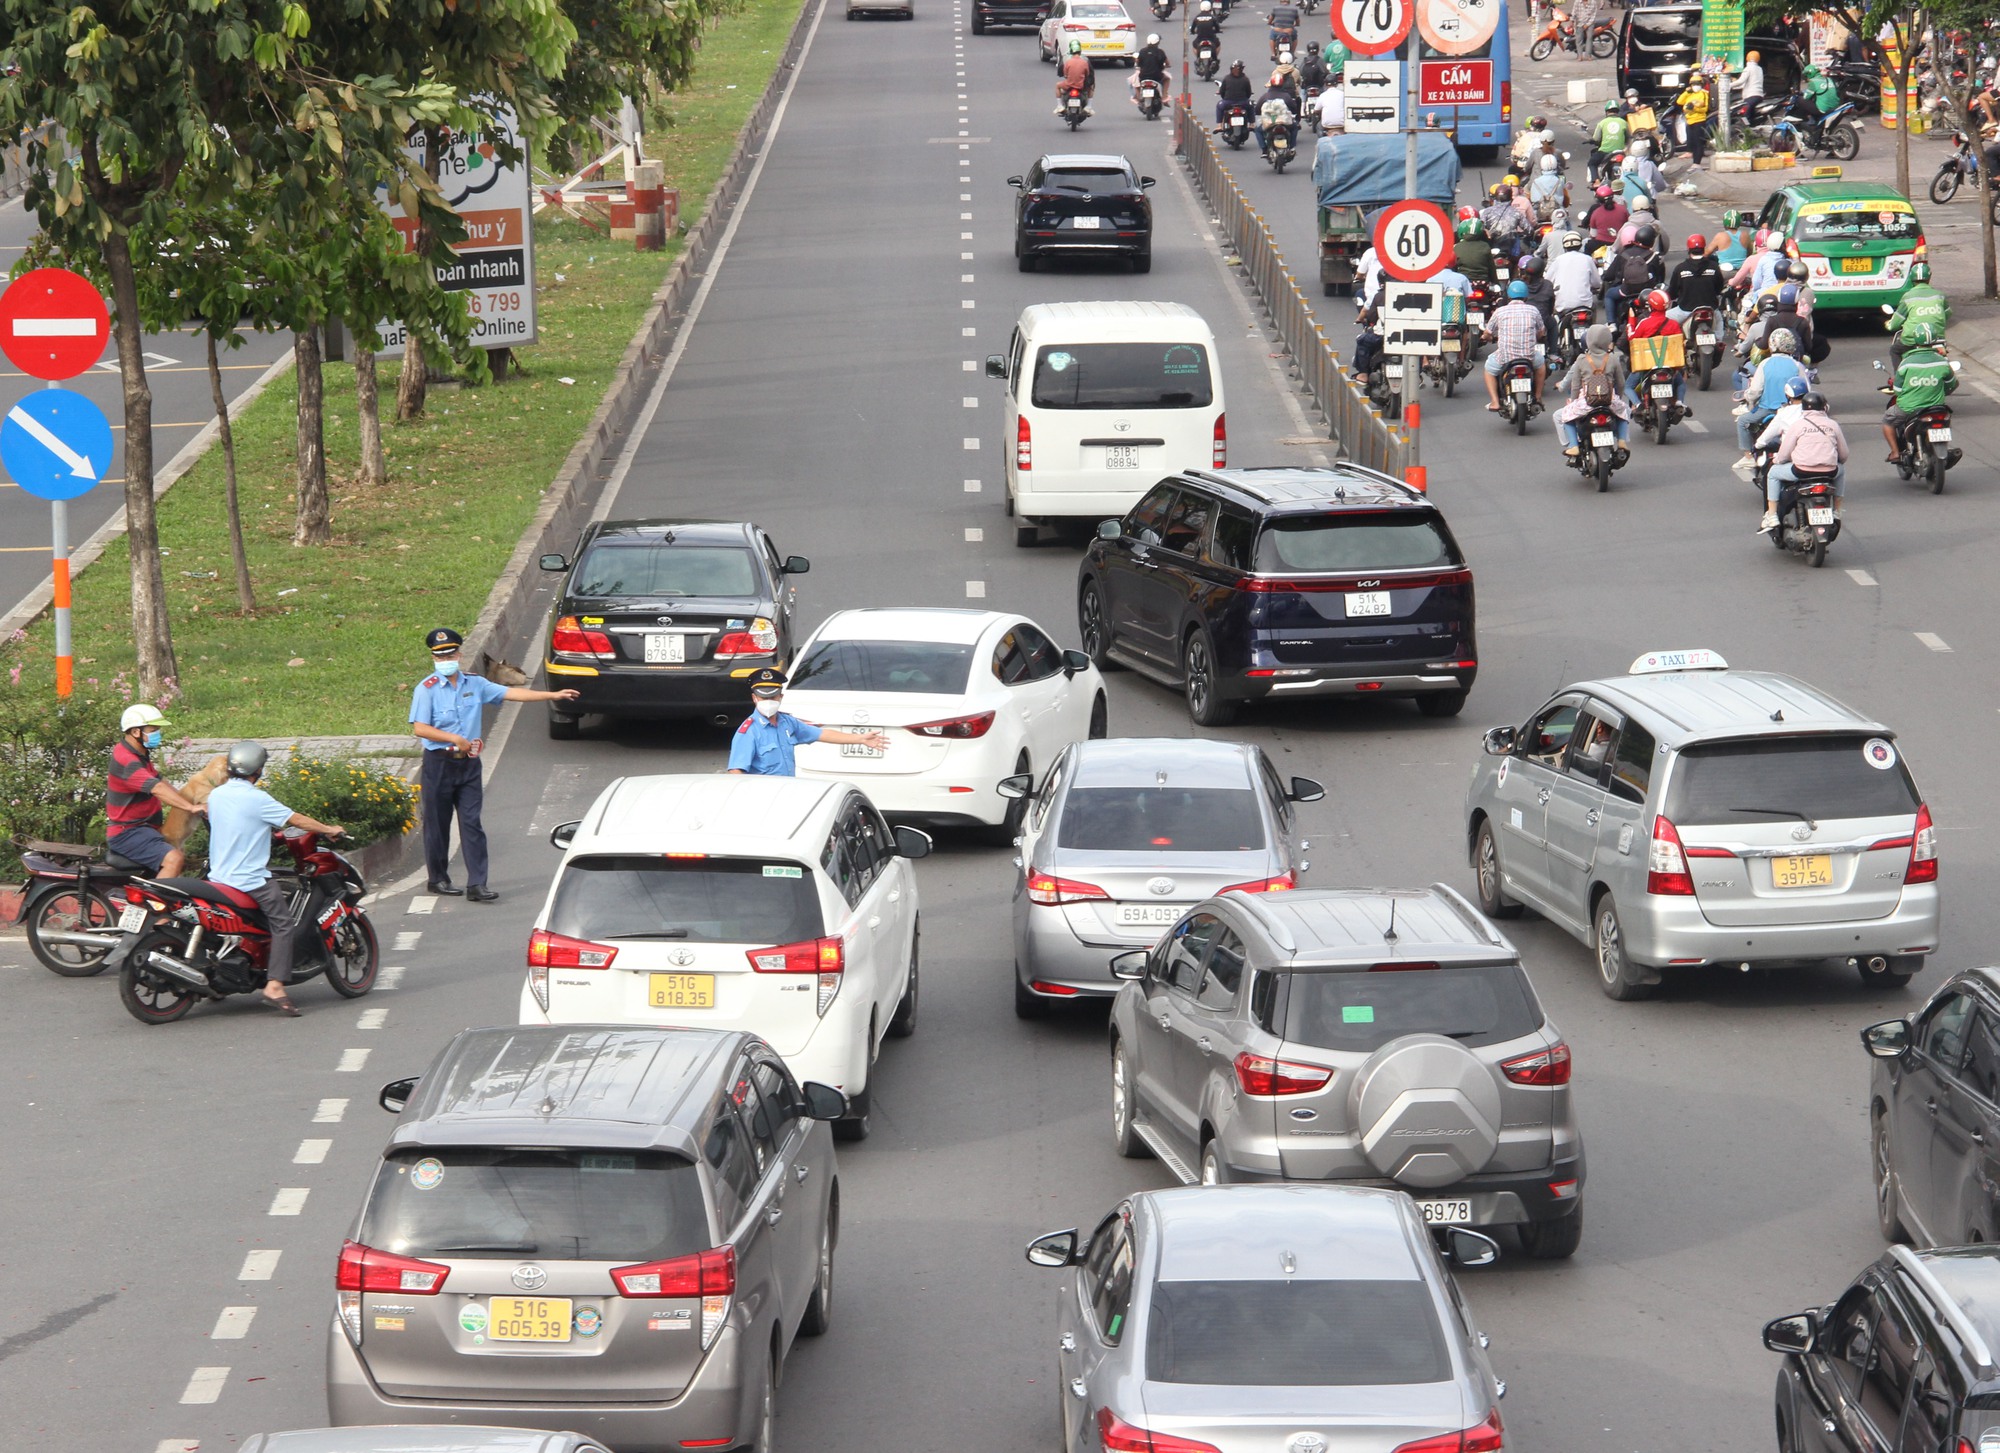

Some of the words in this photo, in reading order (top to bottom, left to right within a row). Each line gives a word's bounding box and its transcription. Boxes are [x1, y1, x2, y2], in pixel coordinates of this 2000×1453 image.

[1356, 0, 1392, 32] 70
[1441, 65, 1472, 86] CẤM
[1428, 91, 1437, 101] XE
[1439, 91, 1445, 101] 2
[1446, 89, 1456, 100] VÀ
[1457, 91, 1462, 100] 3
[1463, 88, 1484, 100] BÁNH
[1829, 202, 1864, 211] MPE
[1883, 224, 1907, 232] 1055
[1397, 225, 1430, 258] 60
[470, 257, 519, 279] nhanh
[488, 292, 520, 313] 799
[1916, 304, 1942, 316] Grab
[1909, 375, 1939, 387] Grab
[1113, 446, 1130, 457] 51B
[1107, 457, 1137, 468] 088.94
[1358, 593, 1378, 604] 51K
[1351, 603, 1387, 616] 424.82
[654, 635, 676, 648] 51F
[646, 648, 684, 662] 878.94
[1660, 654, 1687, 667] TAXI
[1688, 652, 1710, 665] 27-7
[1788, 857, 1815, 872] 51F
[1780, 871, 1828, 886] 397.54
[668, 976, 696, 990] 51G
[656, 990, 707, 1006] 818.35
[514, 1301, 548, 1318] 51G
[498, 1319, 561, 1338] 605.39
